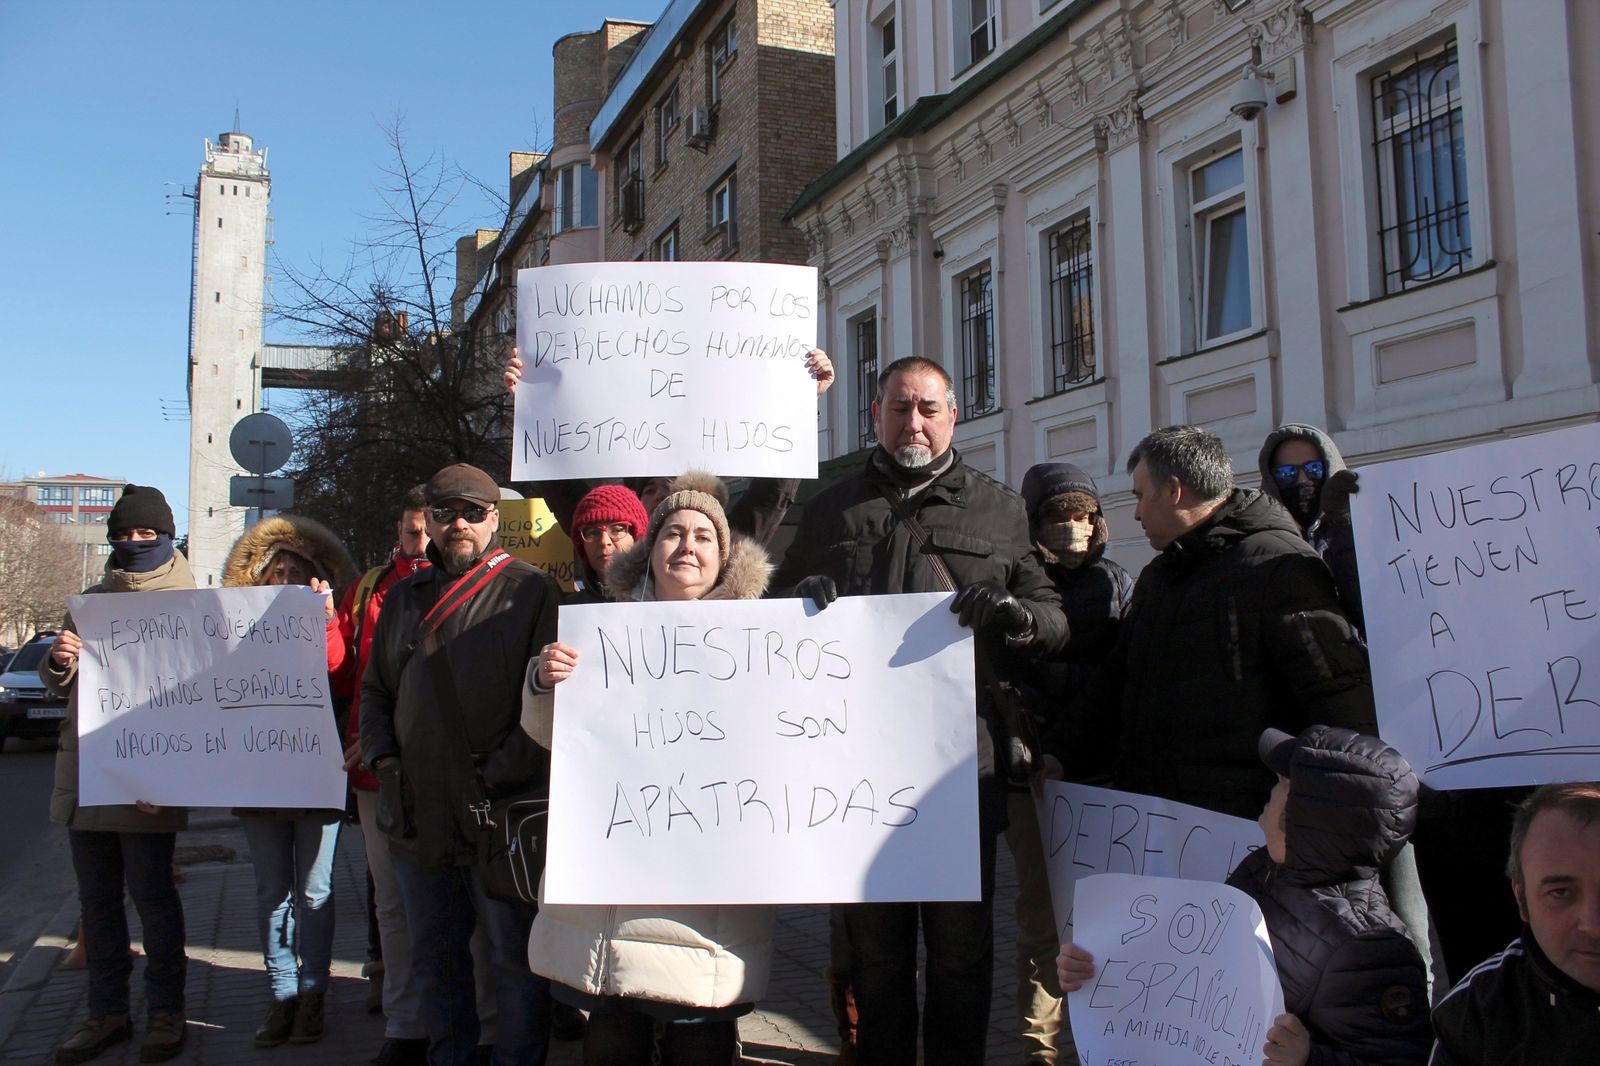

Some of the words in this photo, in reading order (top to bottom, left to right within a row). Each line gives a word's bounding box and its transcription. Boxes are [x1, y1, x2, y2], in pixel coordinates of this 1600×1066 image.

[535, 281, 684, 319] LUCHAMOS
[710, 285, 757, 313] POR
[769, 287, 811, 319] LOS
[535, 326, 690, 369] DERECHOS
[706, 329, 811, 362] HUMANOS
[650, 368, 686, 398] DE
[524, 416, 672, 464] NUESTROS
[702, 417, 793, 453] HIJOS
[1429, 611, 1456, 648] A
[1530, 589, 1597, 631] TE
[598, 624, 851, 688] NUESTROS
[213, 668, 324, 704] ESPAÑOLES
[1425, 655, 1600, 758] DER
[775, 699, 848, 738] SON
[115, 727, 193, 760] NACIDOS
[205, 727, 227, 755] EN
[606, 773, 918, 839] APÁTRIDAS
[1050, 795, 1261, 880] DEREC
[1121, 894, 1236, 956] SOY
[1103, 1019, 1115, 1037] A
[1204, 1044, 1219, 1065] LE
